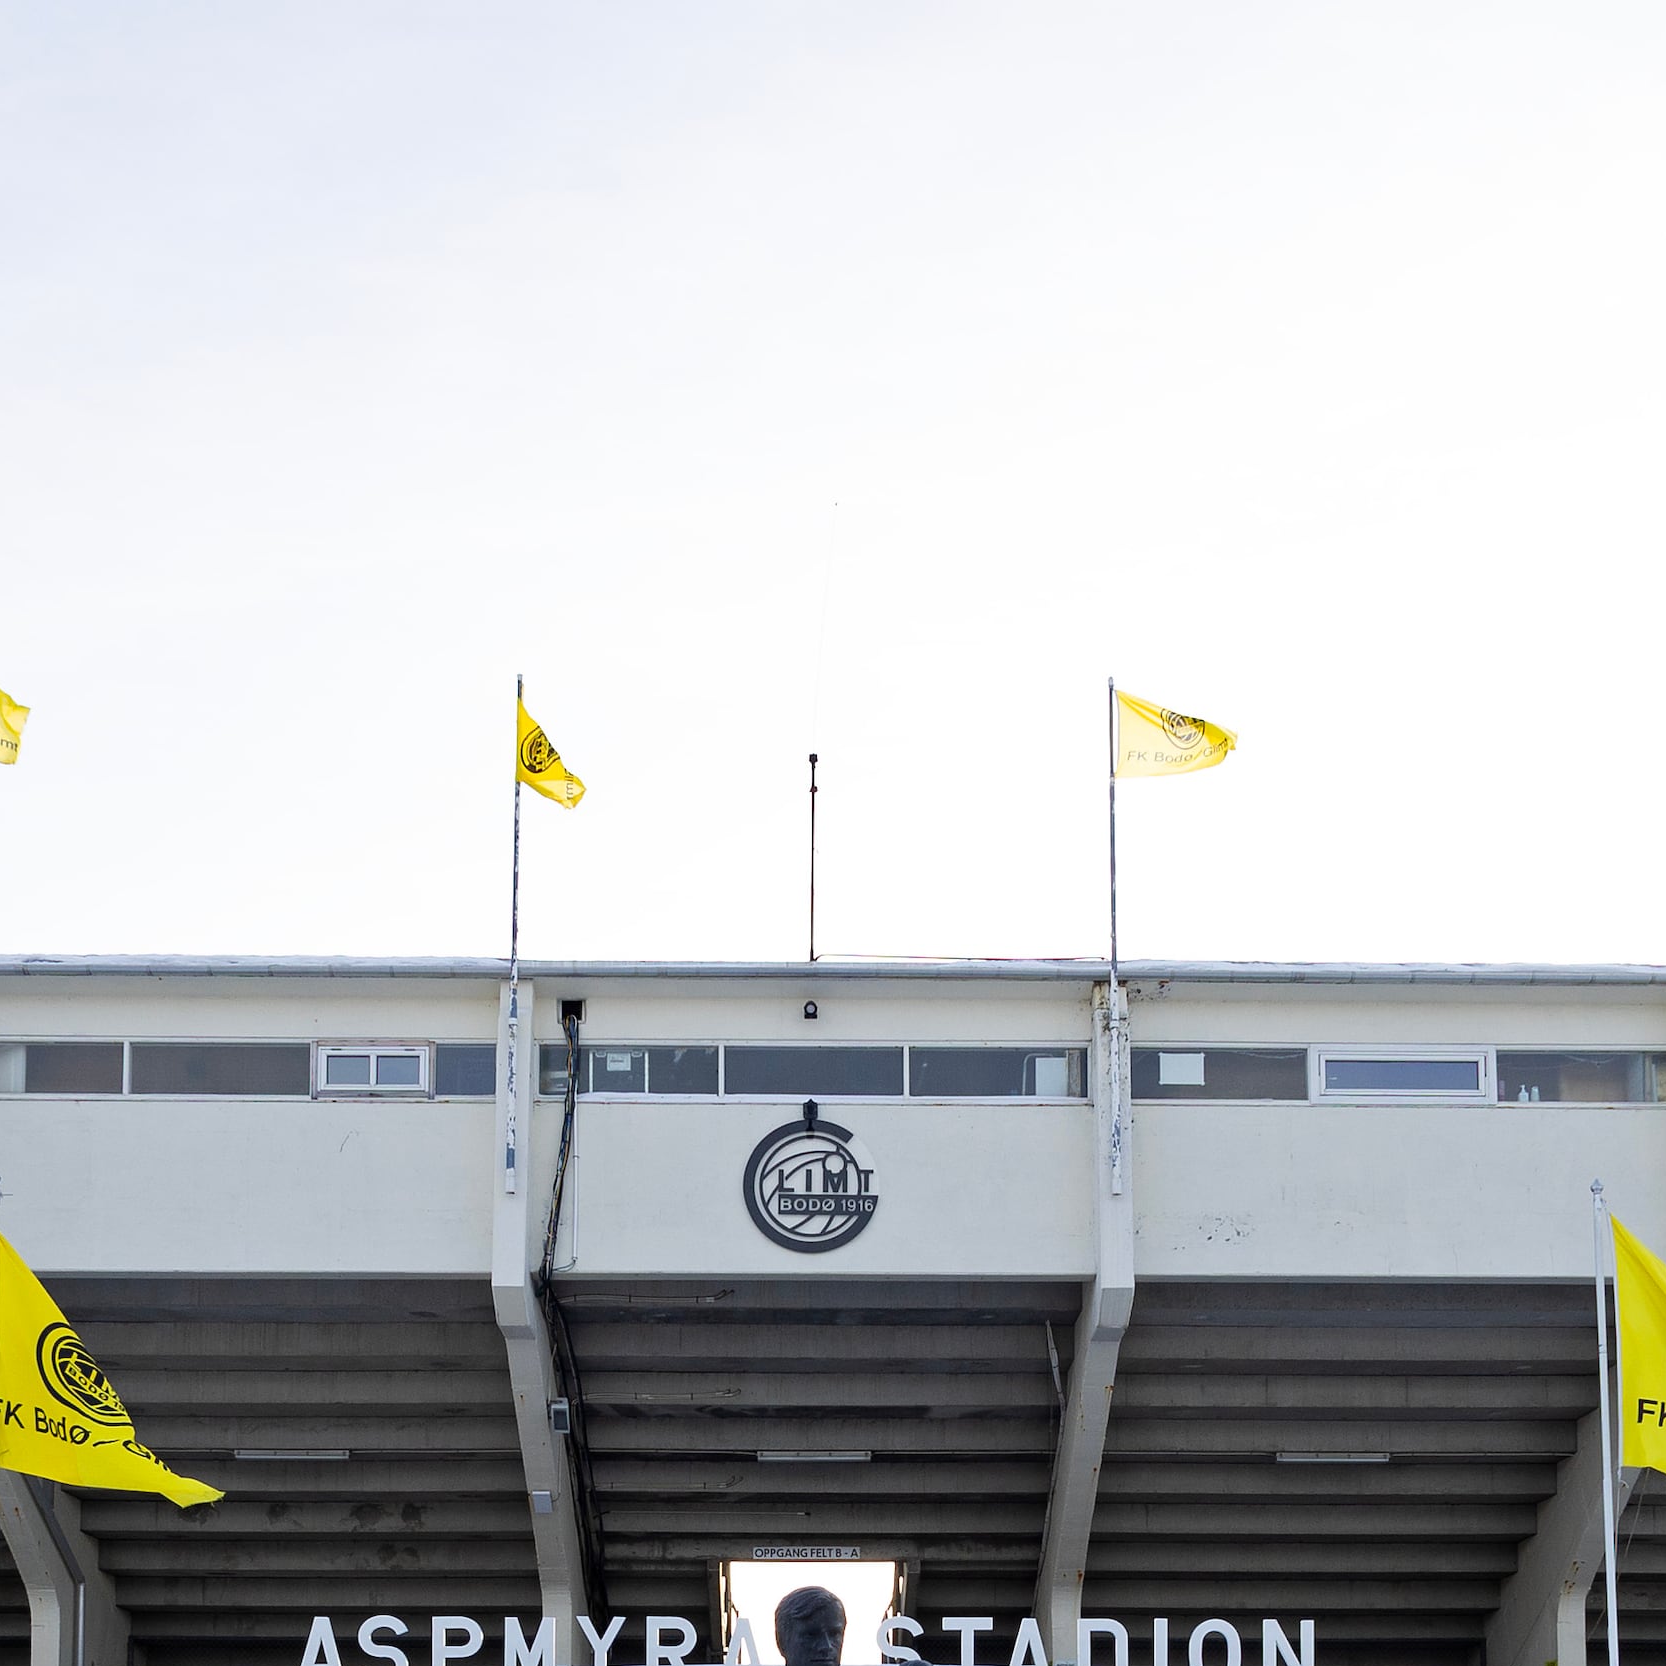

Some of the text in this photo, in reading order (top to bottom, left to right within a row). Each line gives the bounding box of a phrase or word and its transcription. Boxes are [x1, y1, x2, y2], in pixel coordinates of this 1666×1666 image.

[780, 1198, 874, 1212] BODØ 1916
[754, 1548, 808, 1558] OPPGANG
[810, 1548, 835, 1558] FELT
[850, 1548, 859, 1558] A
